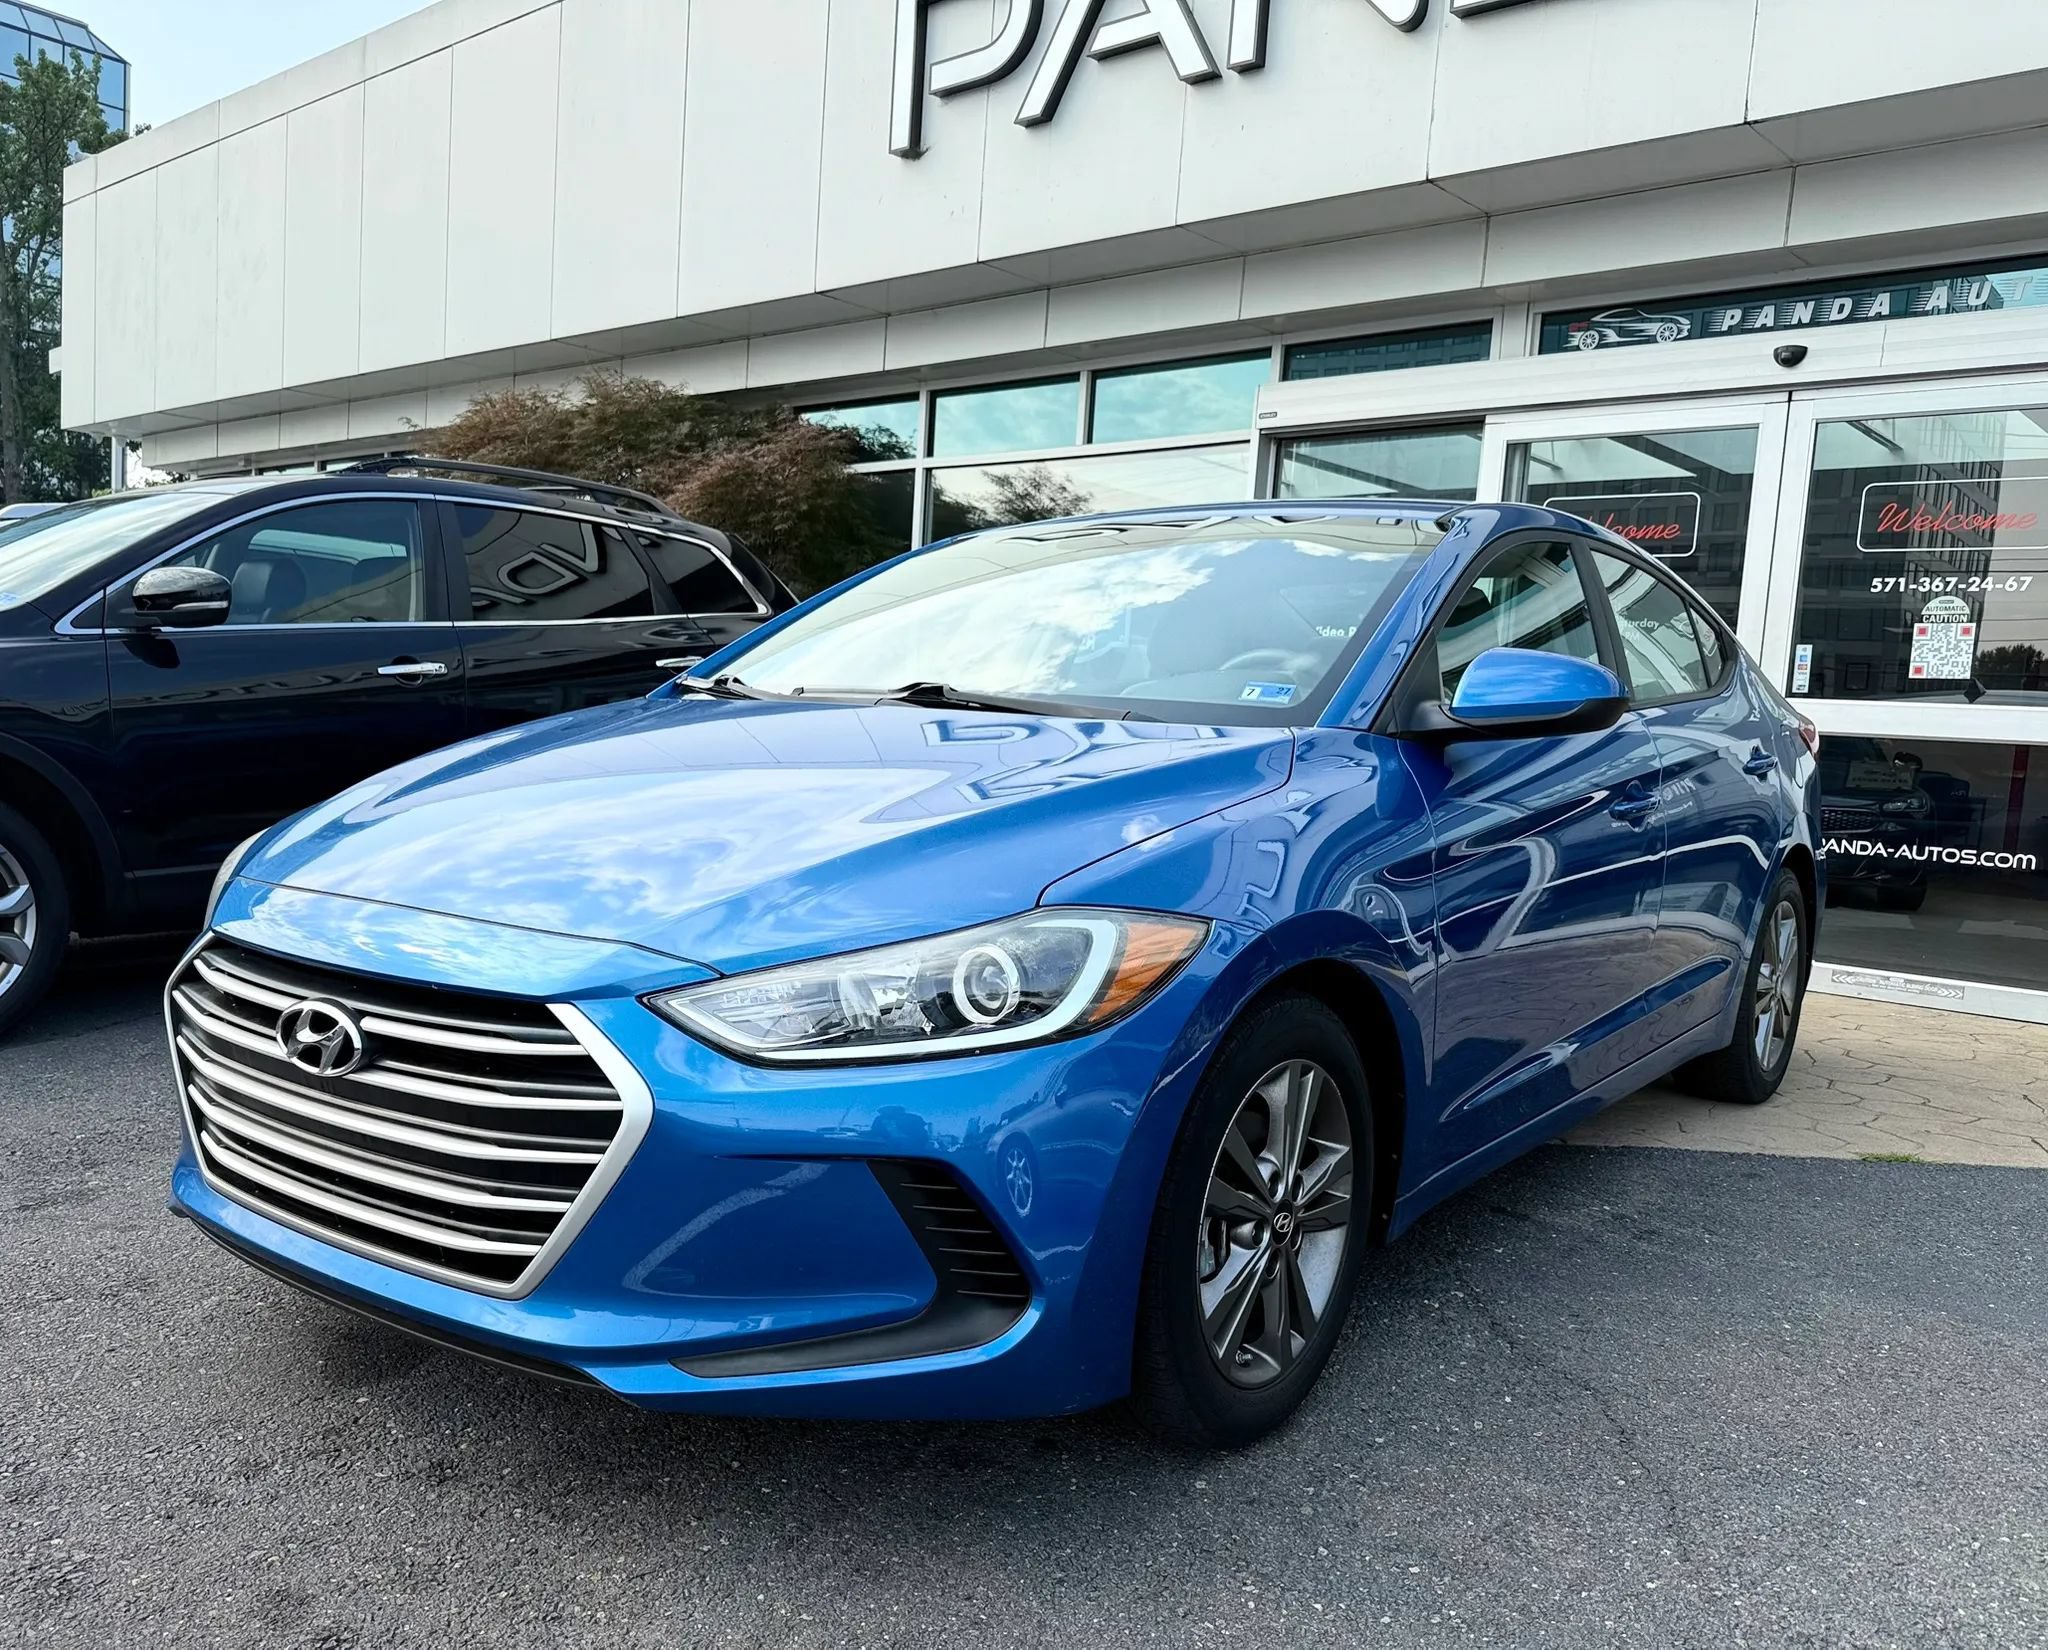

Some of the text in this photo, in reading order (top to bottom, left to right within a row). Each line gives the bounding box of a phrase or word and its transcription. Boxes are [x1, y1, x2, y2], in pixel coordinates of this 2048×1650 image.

[1710, 275, 2034, 332] PANDA AUT
[1877, 500, 2039, 533] Welcome
[1869, 575, 2034, 593] 571-367-24-67
[1922, 614, 1968, 623] CAUTION
